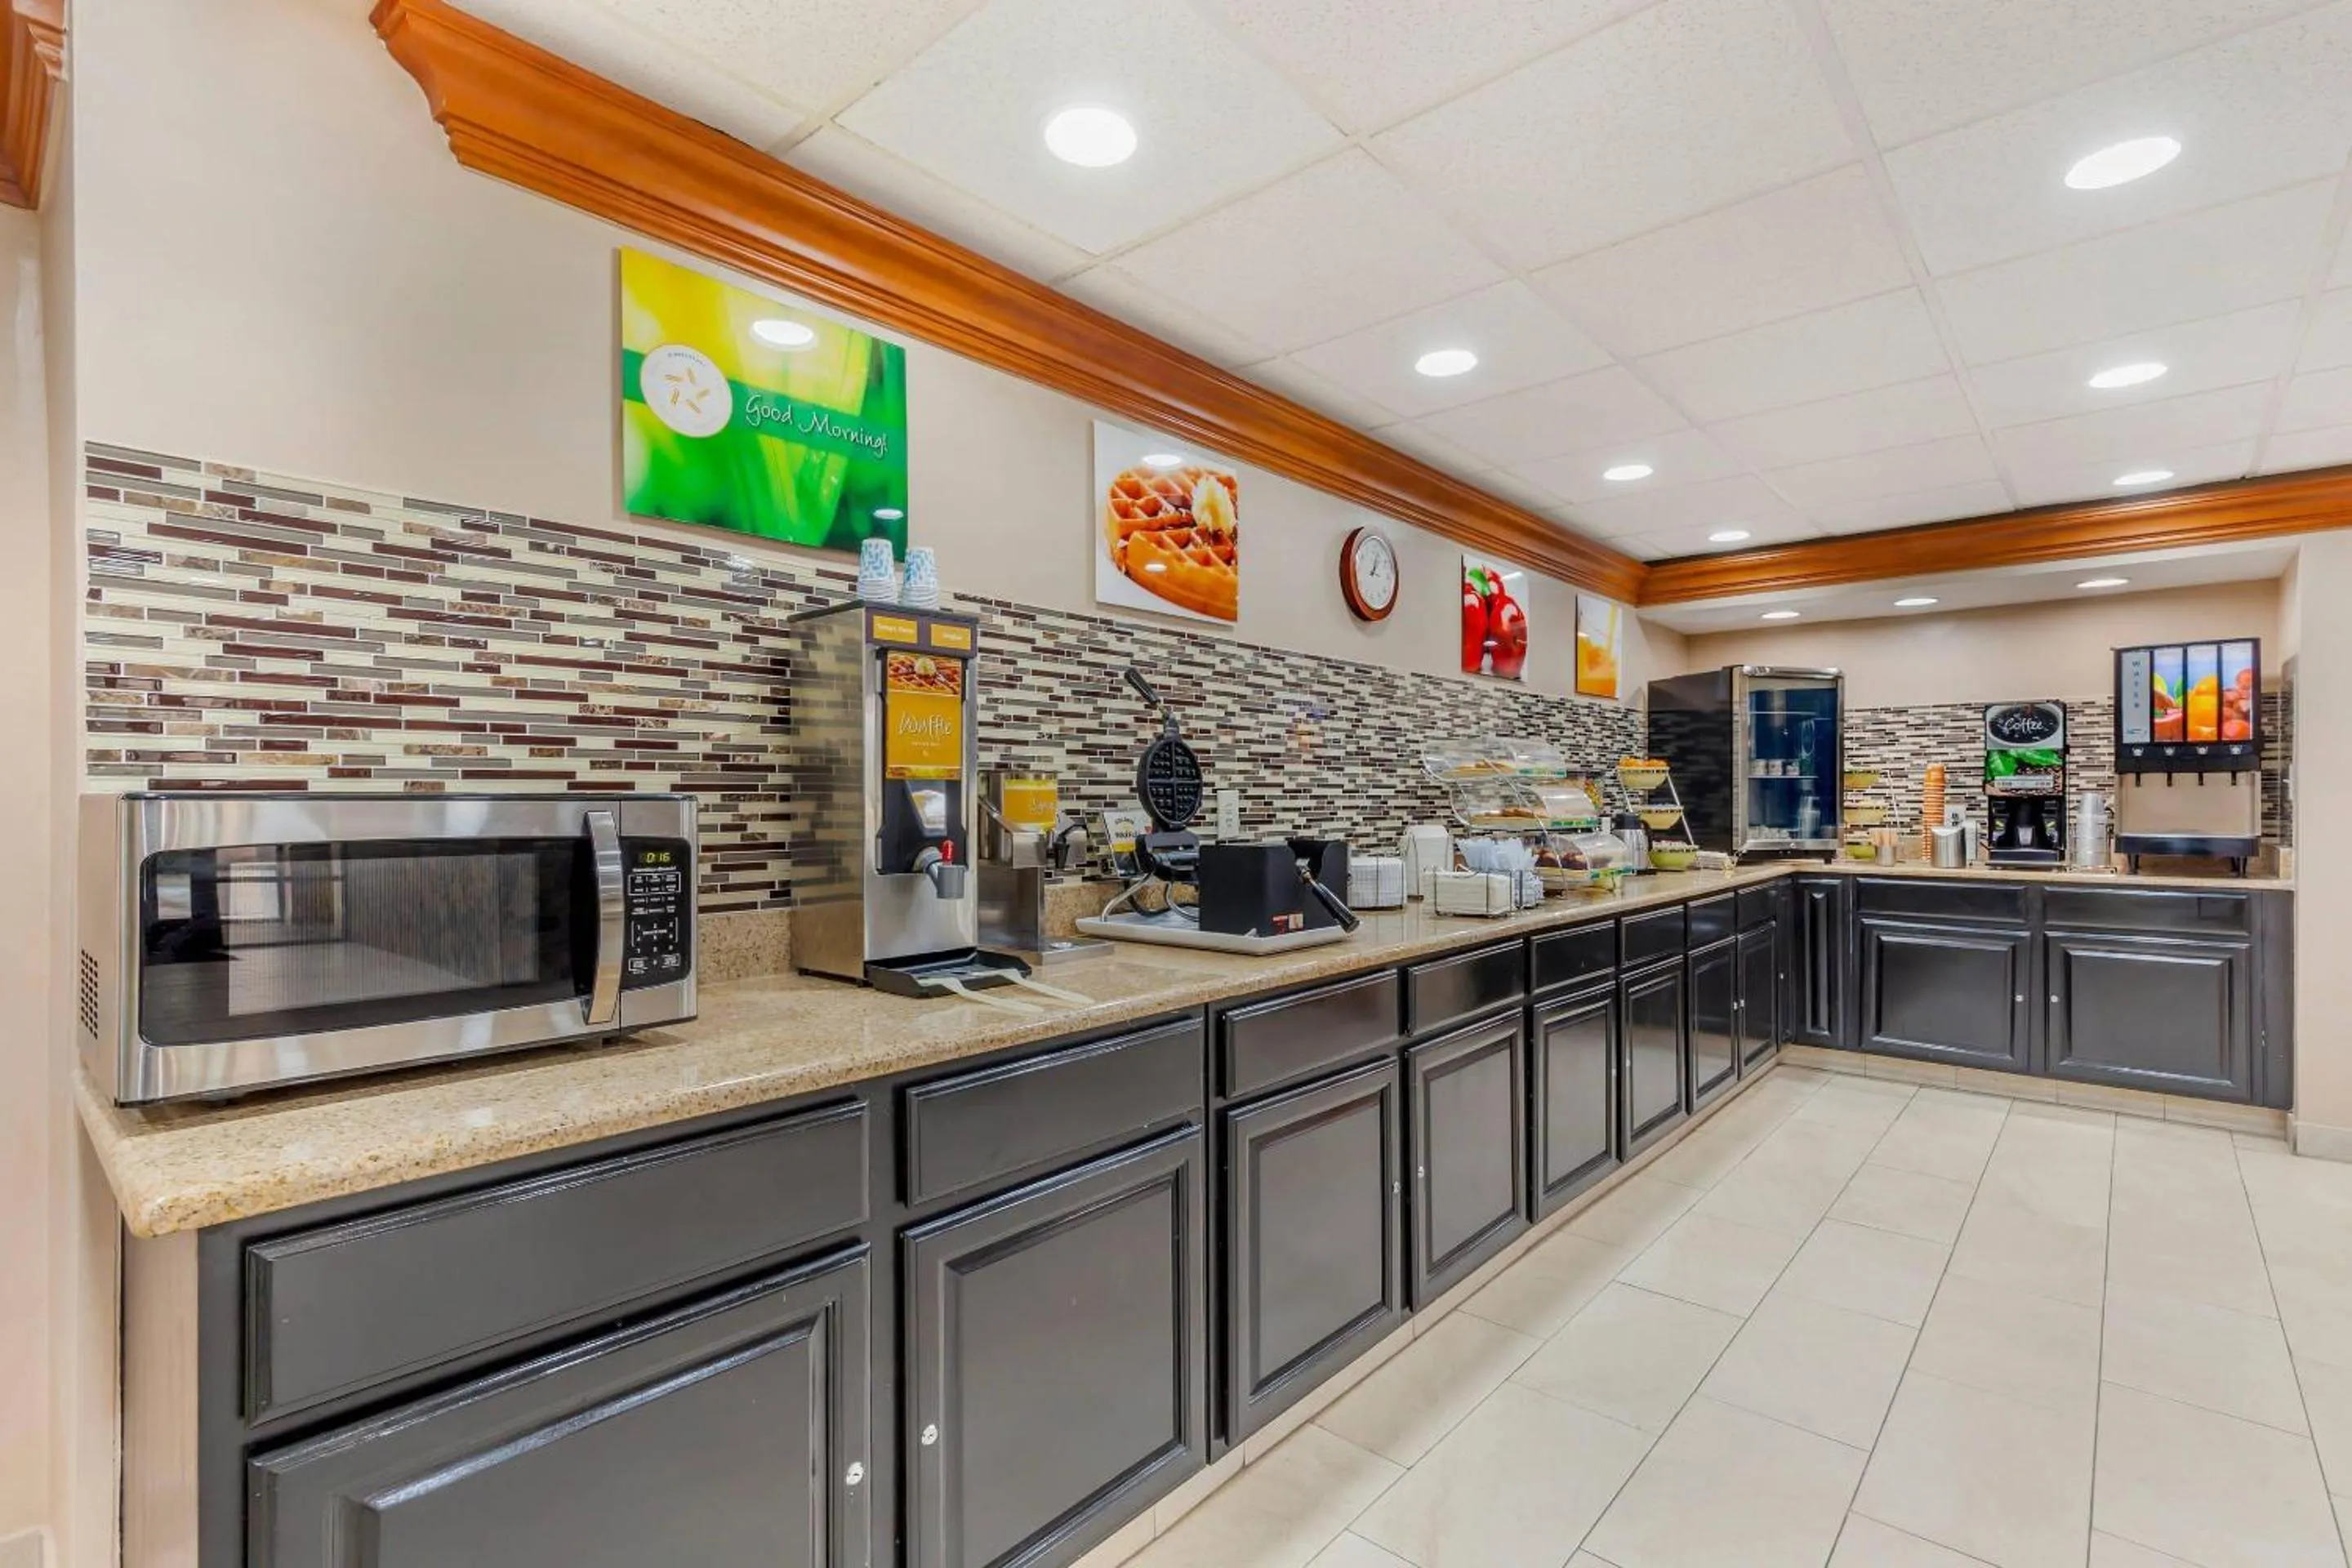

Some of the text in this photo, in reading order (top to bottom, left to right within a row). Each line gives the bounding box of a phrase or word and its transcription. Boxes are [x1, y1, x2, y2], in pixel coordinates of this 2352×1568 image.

[746, 393, 888, 459] Good Morning!
[2004, 717, 2044, 734] Coffee
